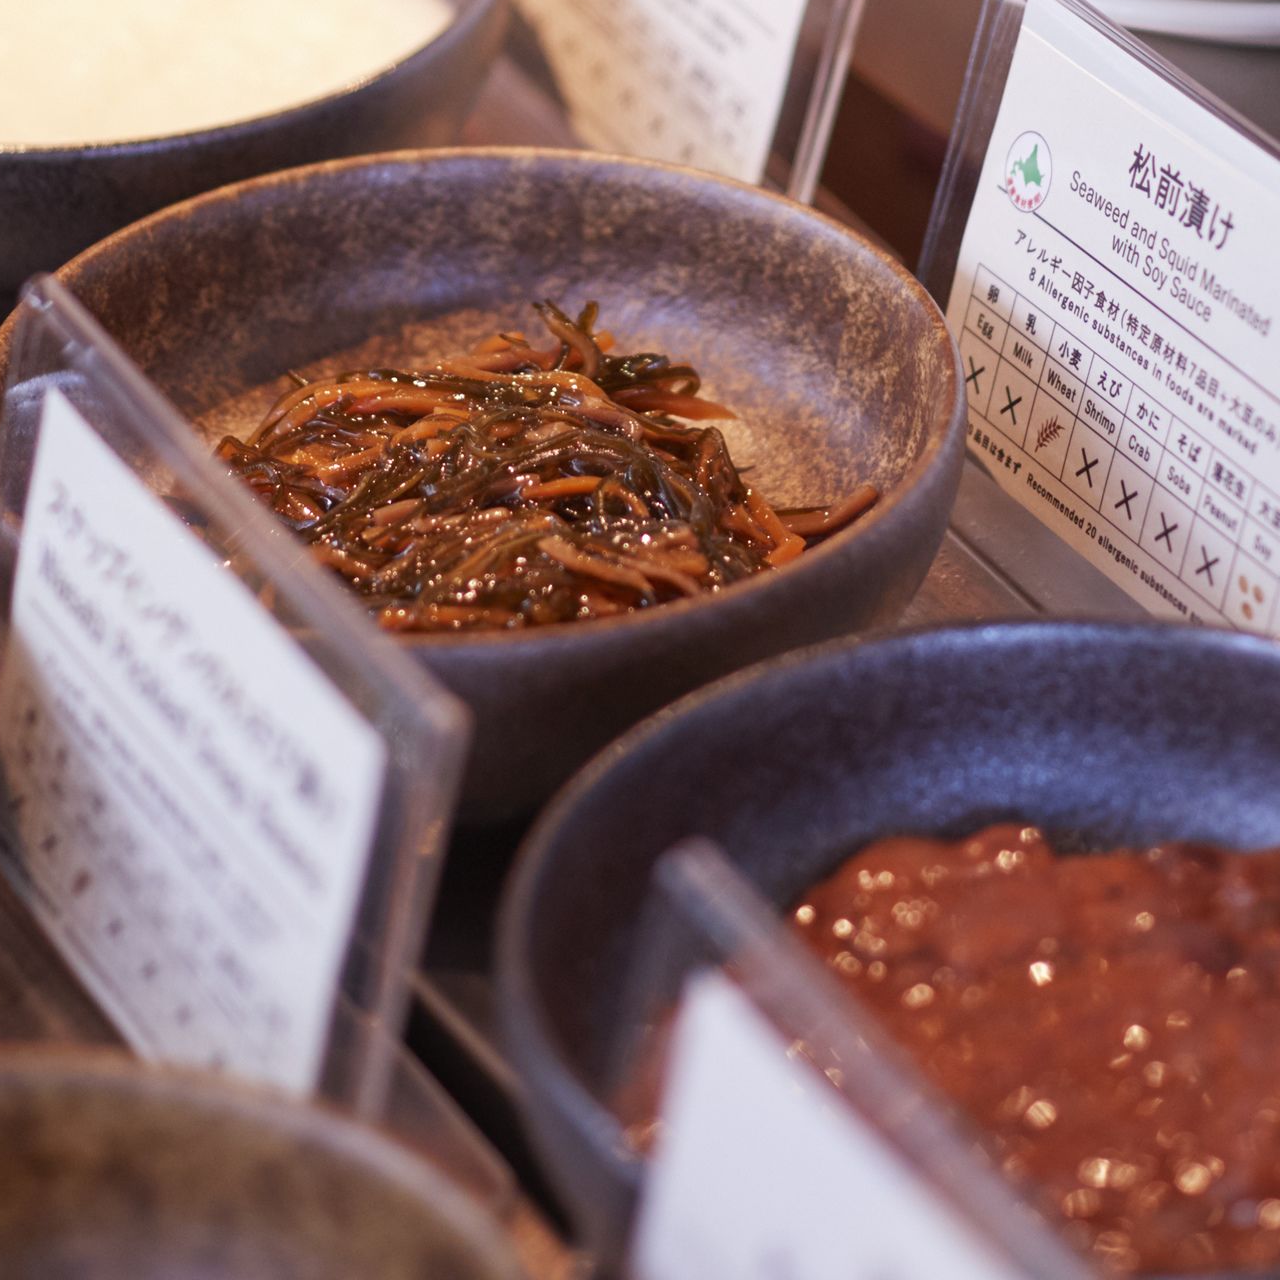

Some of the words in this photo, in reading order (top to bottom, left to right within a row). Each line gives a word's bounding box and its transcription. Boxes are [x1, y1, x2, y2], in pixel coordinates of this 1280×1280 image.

[1070, 170, 1131, 230] Seaweed
[1131, 221, 1157, 250] and
[1158, 237, 1199, 282] Squid
[1200, 269, 1274, 338] Marinated
[1112, 234, 1142, 268] with
[1142, 256, 1169, 291] Soy
[1170, 276, 1213, 323] Sauce
[1128, 143, 1235, 250] 松前漬け
[977, 313, 996, 341] Egg
[1012, 341, 1035, 370] Milk
[1046, 368, 1077, 404] Wheat
[1084, 399, 1117, 435] Shrimp
[1128, 434, 1151, 463] Crab
[1166, 466, 1192, 496] Soba
[987, 285, 1000, 304] 卵
[1025, 314, 1037, 336] 乳
[1058, 341, 1083, 371] 小麦
[1097, 370, 1123, 399] えび
[1136, 402, 1161, 431] かに
[1177, 433, 1203, 463] そば
[1028, 267, 1036, 283] 8
[1038, 274, 1090, 324] Allergenic
[1092, 317, 1149, 371] substances
[1152, 362, 1163, 382] in
[1165, 373, 1195, 406] foods
[1197, 401, 1215, 421] are
[1218, 418, 1259, 456] marked
[1026, 472, 1085, 530] Recommended
[1086, 522, 1097, 540] 20
[1097, 535, 1138, 575] allergenic
[1140, 570, 1188, 615] substances
